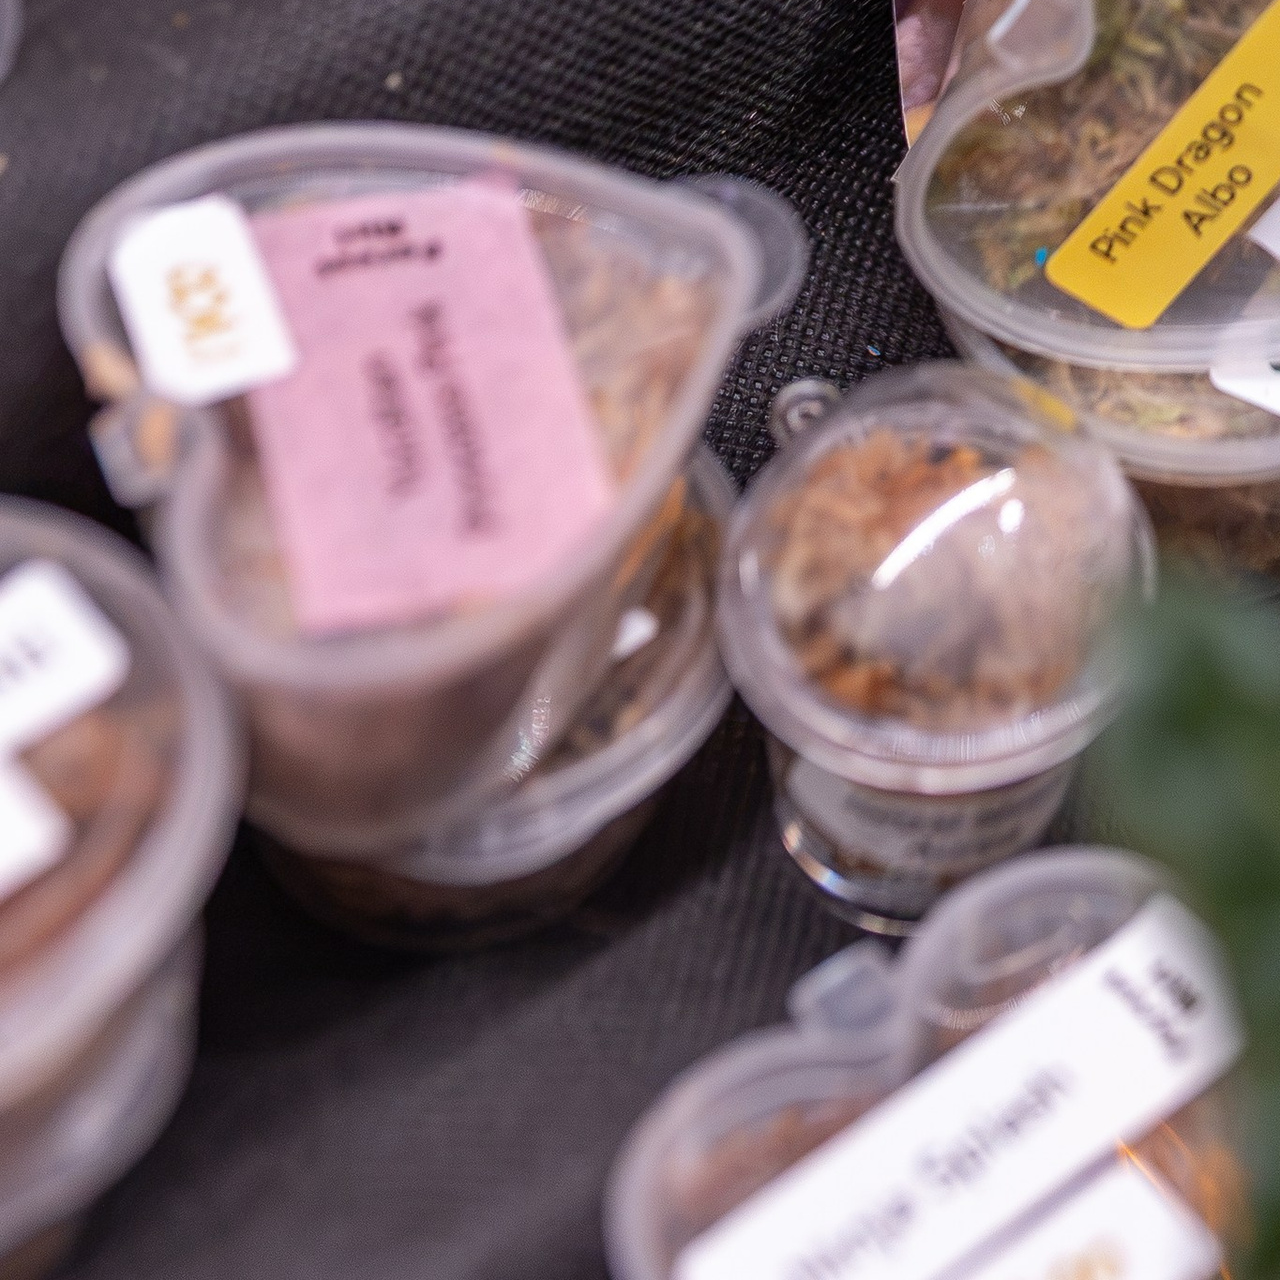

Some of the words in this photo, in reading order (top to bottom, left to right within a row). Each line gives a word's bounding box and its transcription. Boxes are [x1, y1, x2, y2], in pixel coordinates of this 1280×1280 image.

[1089, 196, 1162, 265] Pink
[1148, 82, 1264, 197] Dragon
[1183, 164, 1254, 238] Albo
